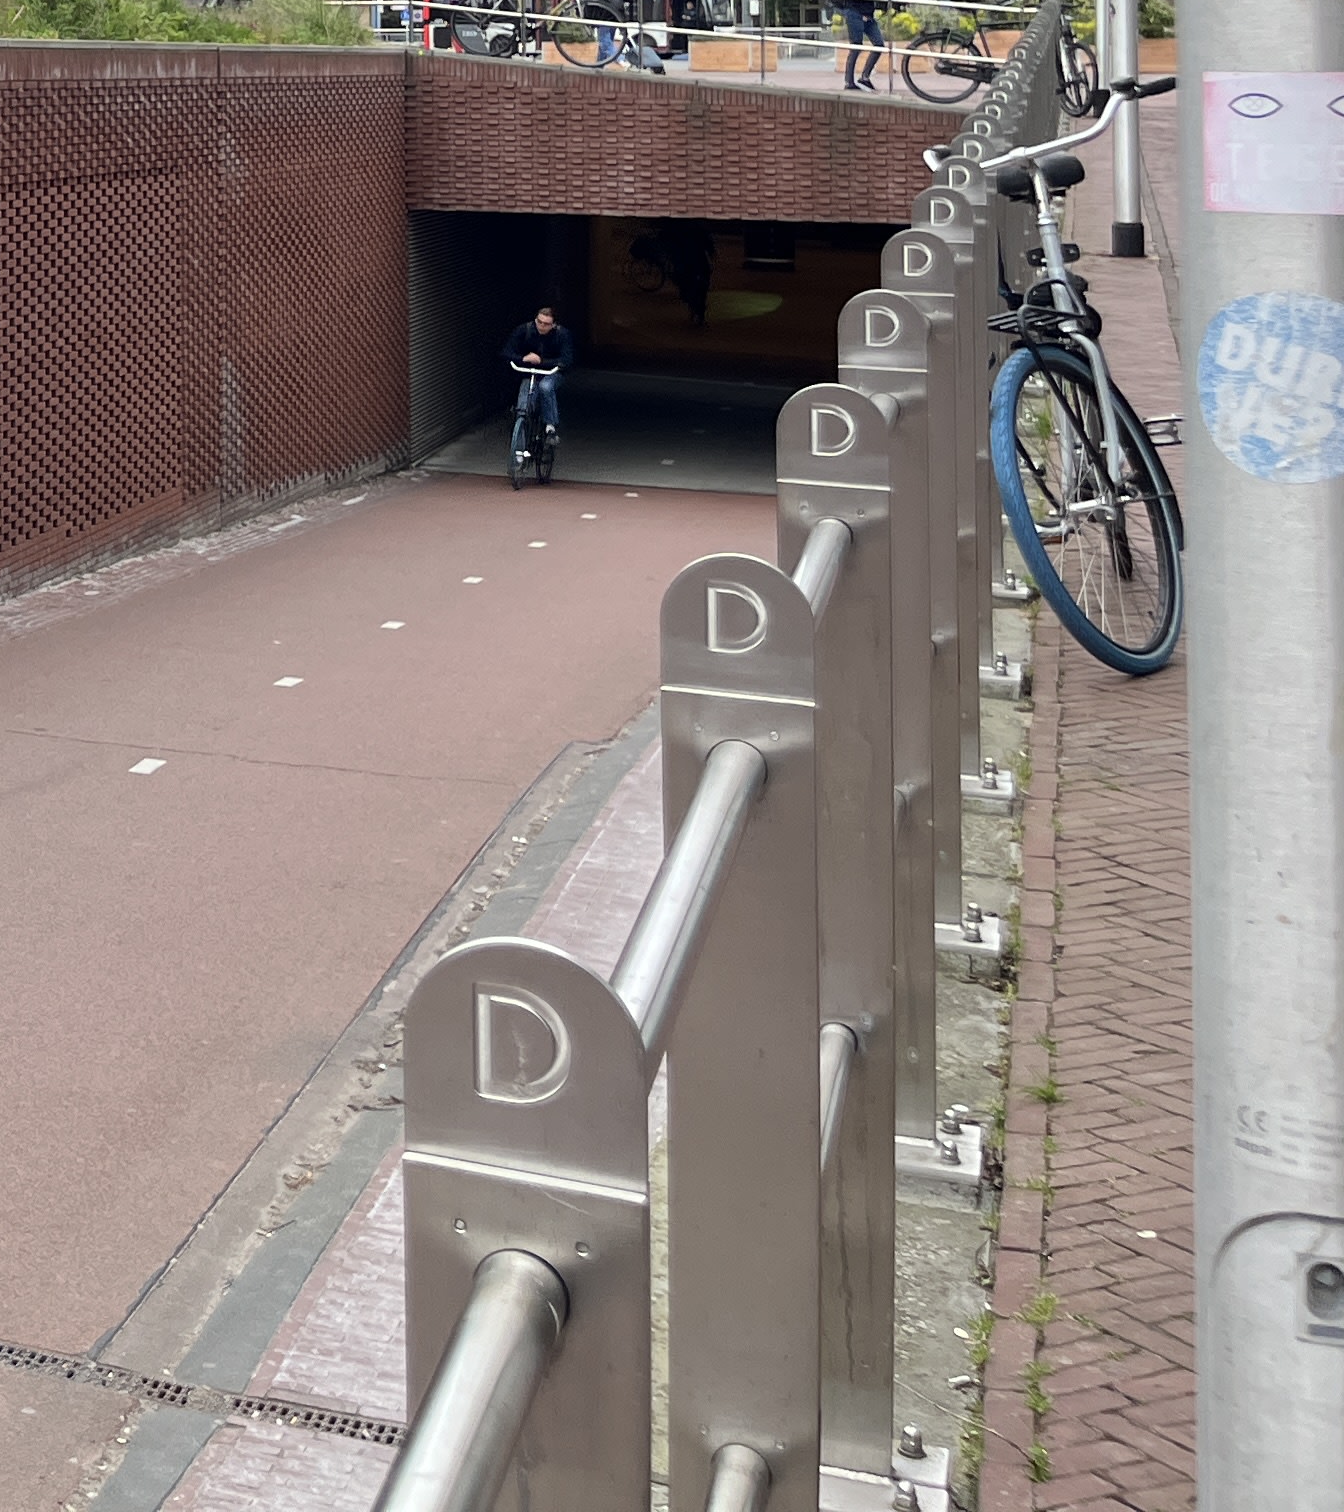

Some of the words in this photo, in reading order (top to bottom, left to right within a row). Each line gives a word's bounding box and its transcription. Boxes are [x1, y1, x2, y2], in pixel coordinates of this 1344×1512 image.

[947, 164, 971, 188] D
[929, 196, 955, 227] D
[902, 241, 933, 277] D
[863, 304, 902, 348] D
[809, 402, 858, 458] D
[704, 579, 770, 655] D
[472, 982, 572, 1104] D
